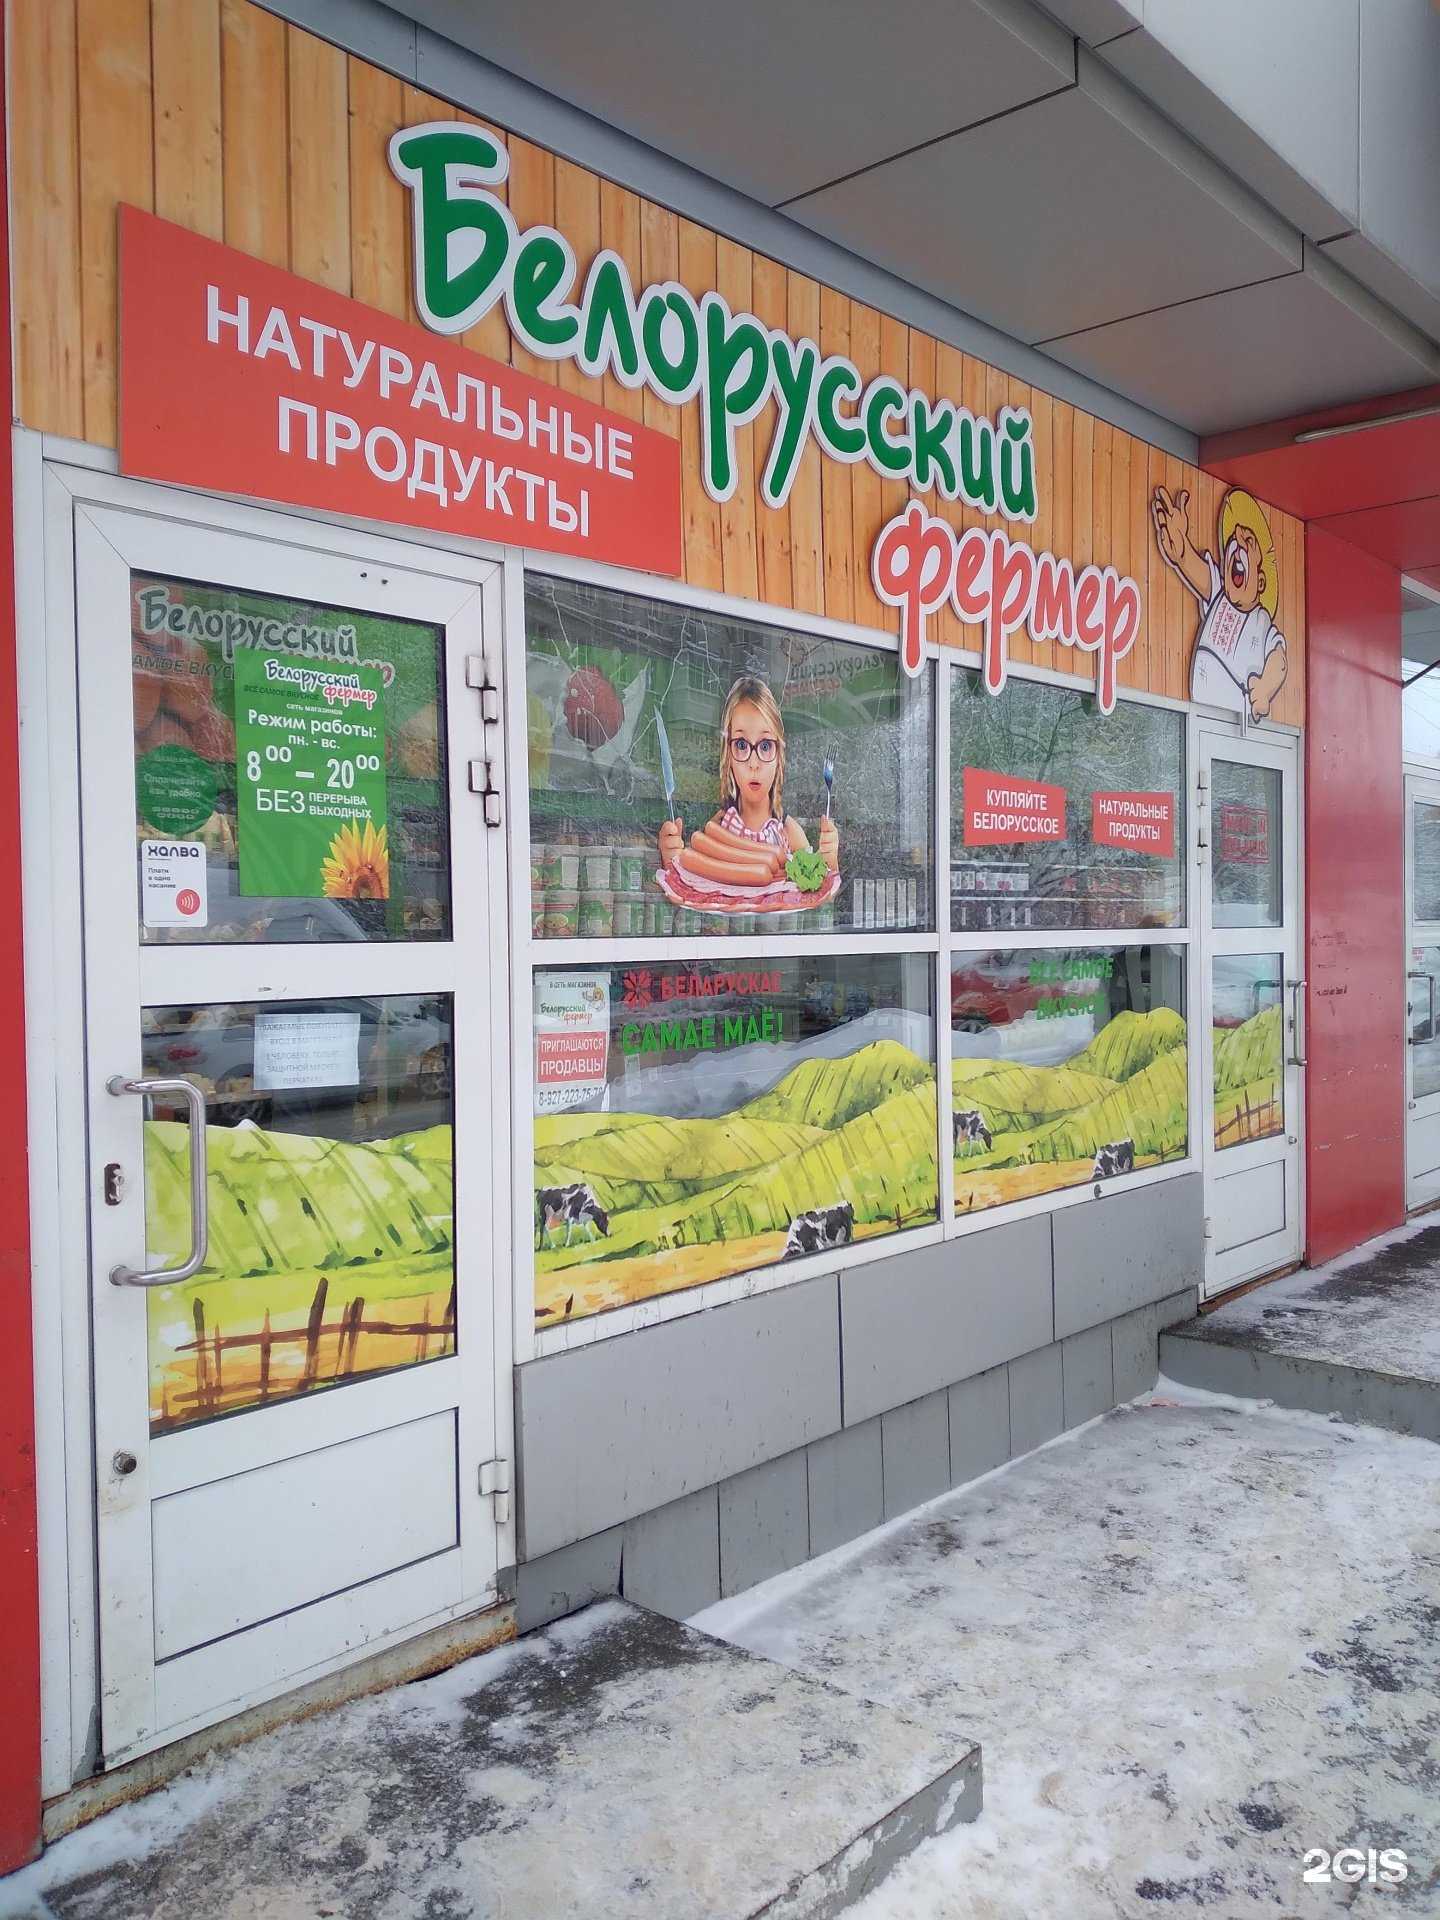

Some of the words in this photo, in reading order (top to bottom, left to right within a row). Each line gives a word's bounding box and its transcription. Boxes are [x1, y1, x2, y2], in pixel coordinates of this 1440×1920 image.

[395, 128, 1037, 518] Белорусский
[206, 284, 634, 480] НАТУРАЛЬНЫЕ
[278, 395, 589, 537] ПРОДУКТЫ
[877, 507, 1139, 710] фермер
[139, 588, 355, 659] Белорусский
[133, 654, 184, 673] АМОЕ
[265, 660, 359, 690] Белорусский
[323, 686, 377, 710] фермер
[248, 709, 306, 730] Режим
[311, 719, 377, 738] работы:
[288, 734, 309, 746] пн.
[321, 738, 340, 749] вс.
[256, 788, 306, 813] БЕЗ
[309, 792, 367, 806] ПЕРЕРЫВА
[309, 805, 372, 818] ВЫХОДНЫХ
[986, 789, 1048, 811] КУПЛЯЙТЕ
[1099, 800, 1169, 820] НАТУРАЛЬНЫЕ
[973, 812, 1060, 835] БЕЛОРУССКОЕ
[1109, 822, 1161, 840] ПРОДУКТЫ
[661, 971, 783, 999] БЕЛАРУСКАЕ
[622, 1015, 716, 1055] САМАЕ
[724, 1006, 783, 1046] МАЁ!
[541, 1038, 604, 1053] ПРИГЛАШАЮТСЯ
[541, 1058, 604, 1076] ПРОДАВЦЫ
